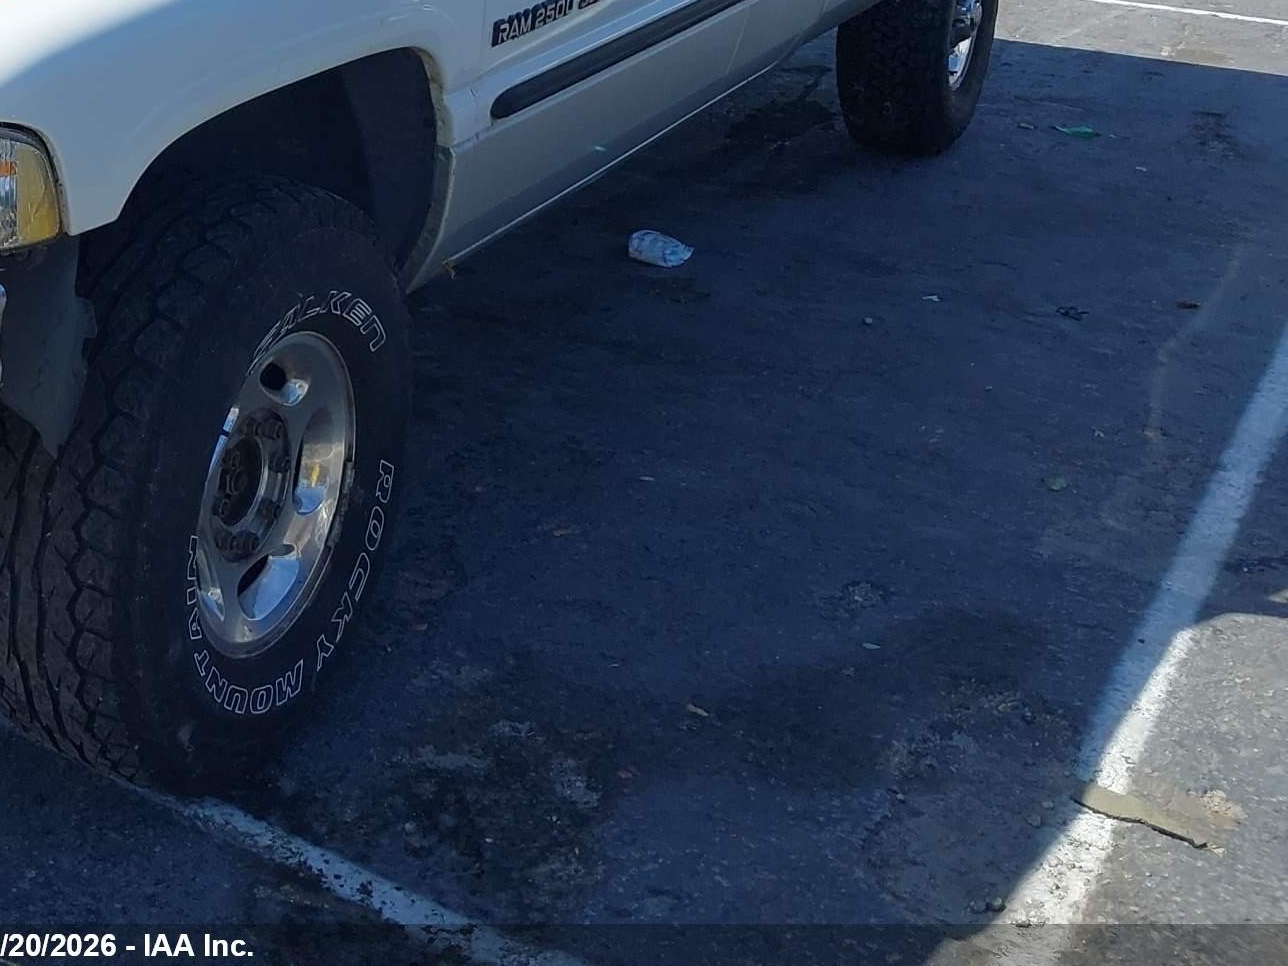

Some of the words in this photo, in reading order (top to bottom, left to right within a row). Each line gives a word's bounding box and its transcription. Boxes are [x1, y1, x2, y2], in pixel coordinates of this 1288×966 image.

[491, 7, 533, 48] RAM
[245, 290, 387, 376] FALKEN
[186, 535, 305, 715] MOUNTAIN
[315, 459, 395, 672] ROCKY
